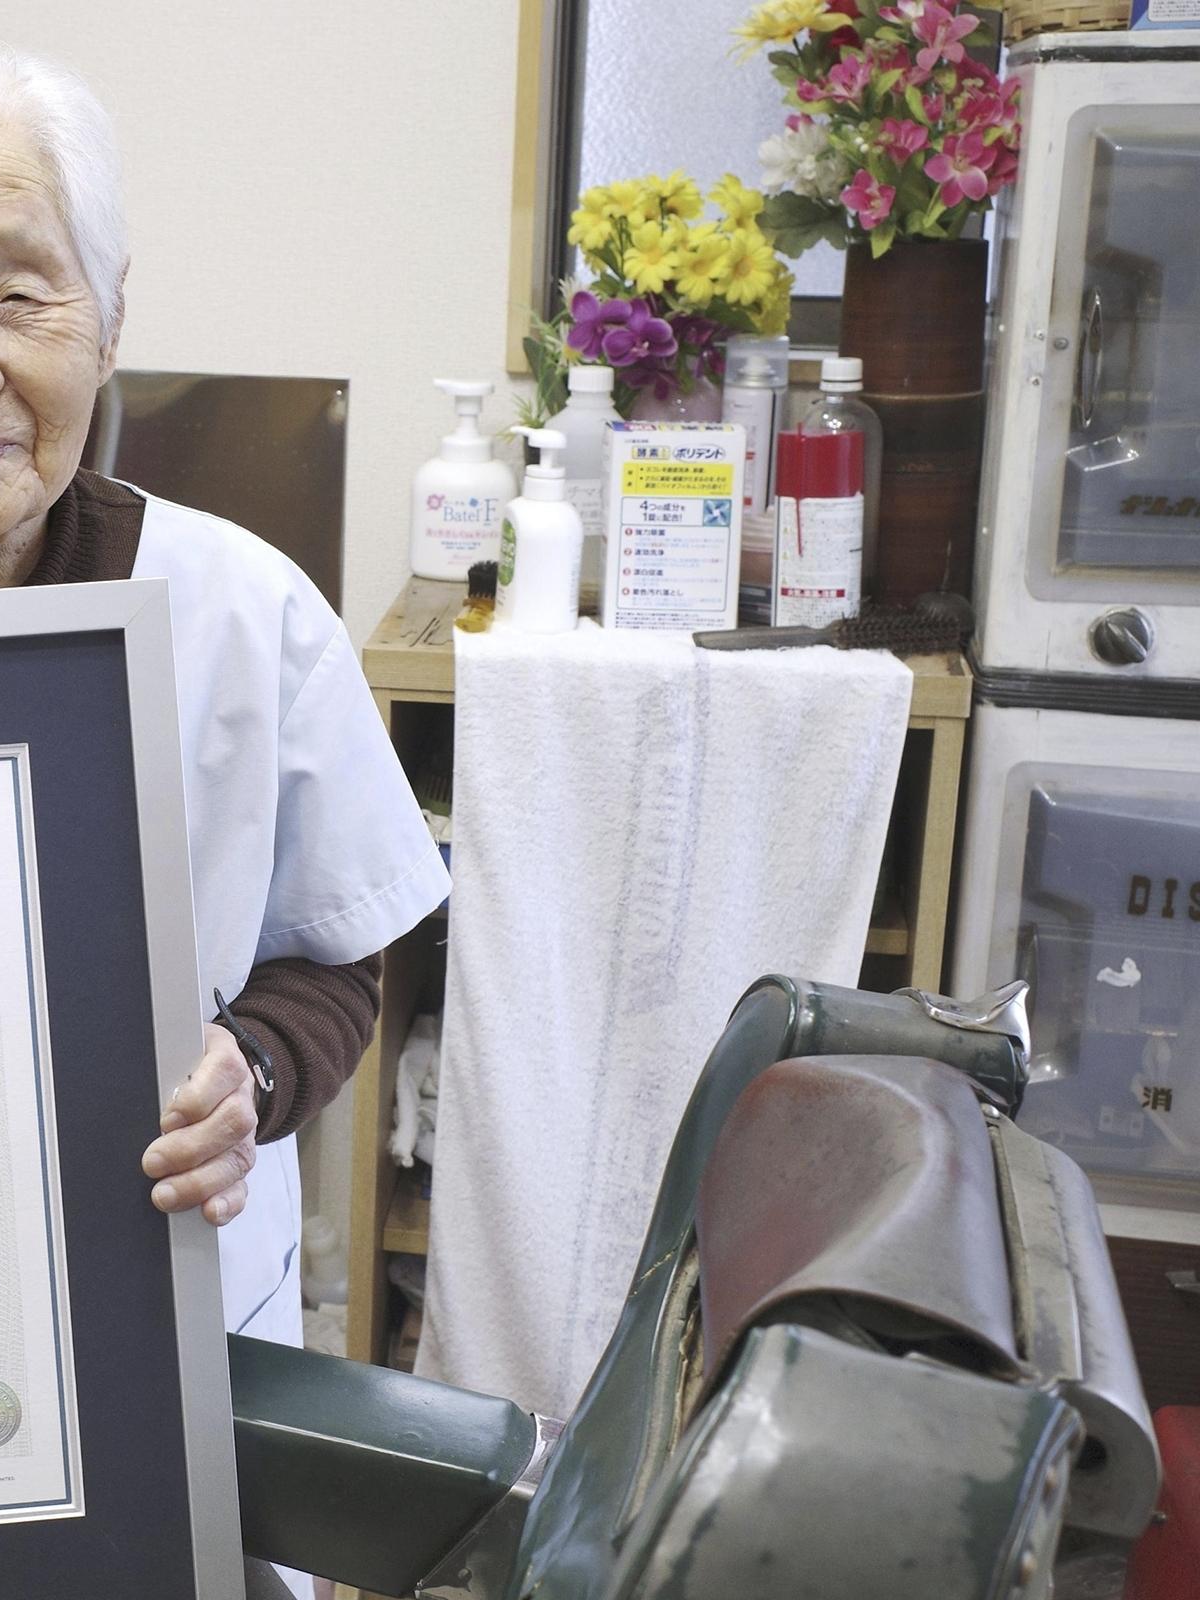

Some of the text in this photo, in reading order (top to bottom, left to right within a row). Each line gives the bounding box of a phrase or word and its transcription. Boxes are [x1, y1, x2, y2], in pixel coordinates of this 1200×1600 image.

[676, 448, 724, 459] ポリデント
[484, 498, 499, 522] F
[1141, 1085, 1173, 1112] 消
